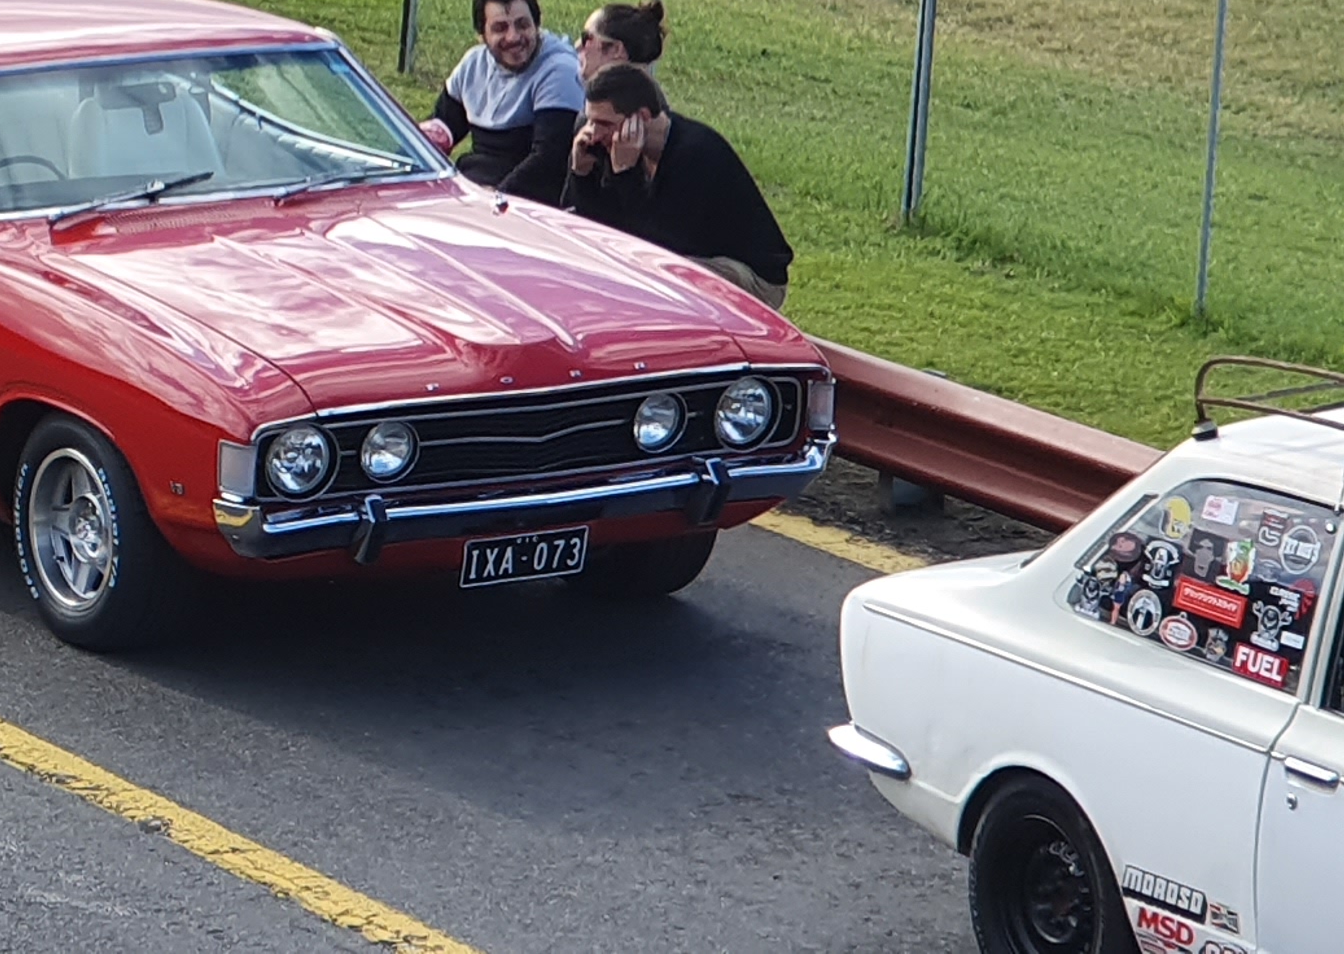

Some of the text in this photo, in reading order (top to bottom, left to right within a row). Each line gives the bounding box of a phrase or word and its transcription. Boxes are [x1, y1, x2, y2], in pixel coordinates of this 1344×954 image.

[469, 538, 581, 579] IXA-073
[1234, 645, 1283, 682] FUEL
[1123, 868, 1204, 915] MOROSO
[1137, 906, 1195, 946] MSD
